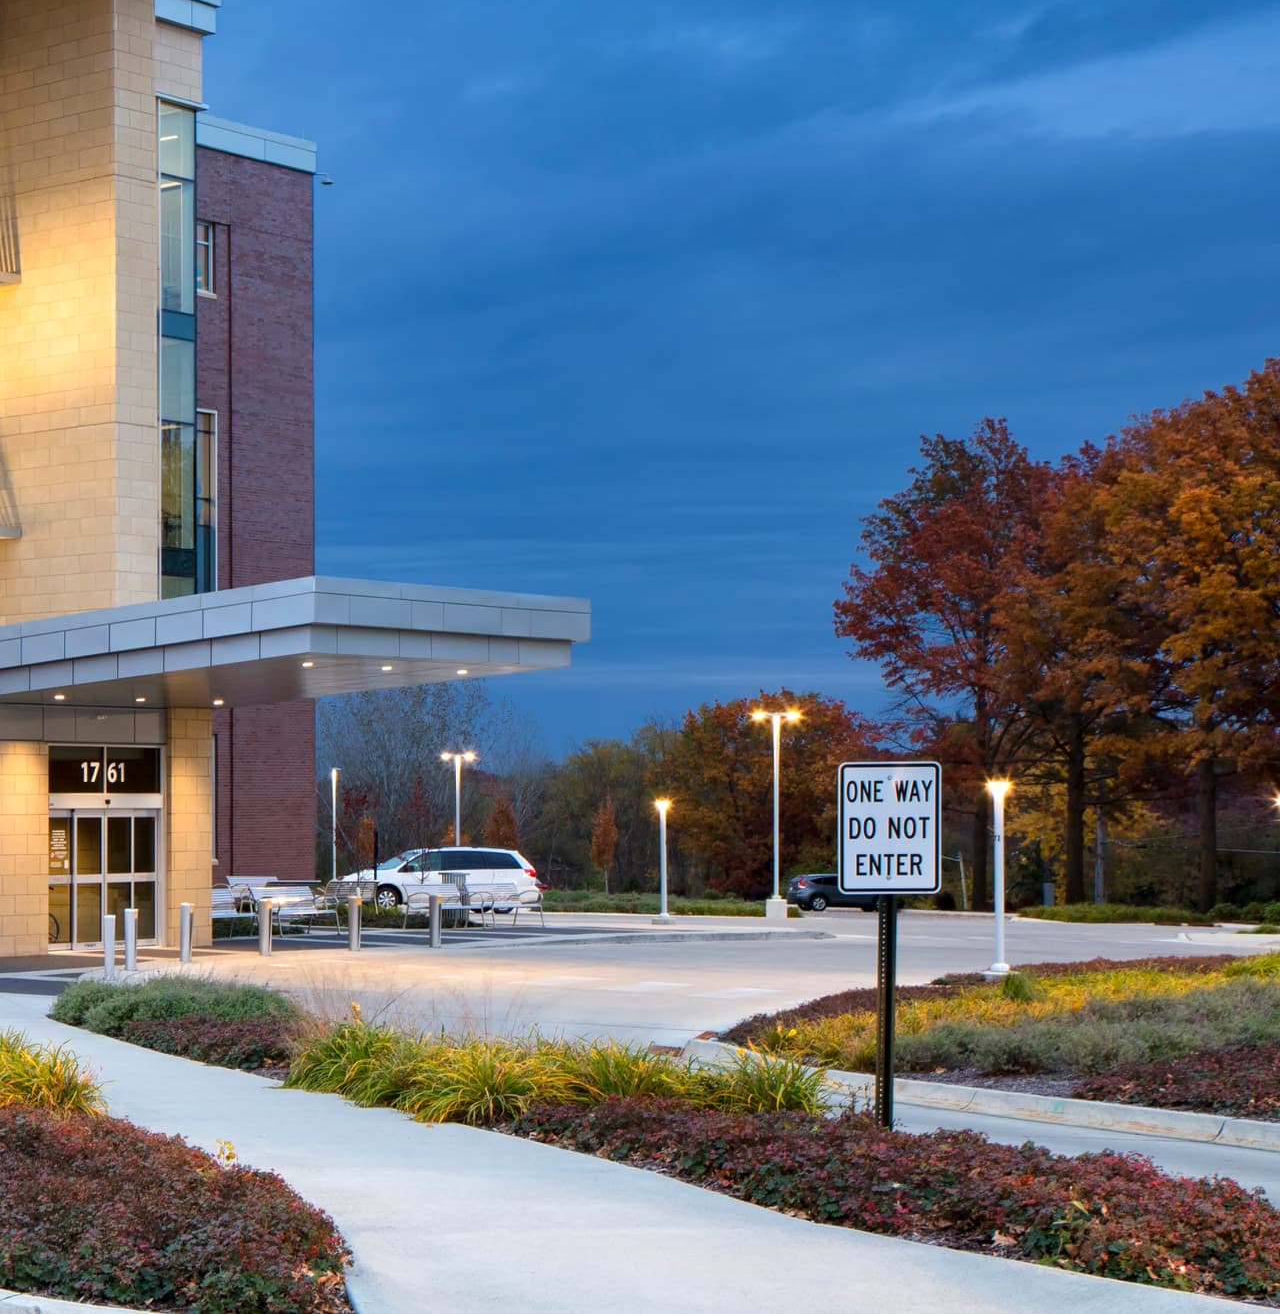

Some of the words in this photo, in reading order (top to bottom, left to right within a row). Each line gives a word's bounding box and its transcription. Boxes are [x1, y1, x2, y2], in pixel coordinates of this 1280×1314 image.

[80, 761, 126, 783] 1761
[846, 779, 884, 803] ONE
[894, 779, 933, 803] WAY
[848, 816, 876, 840] DO
[888, 816, 930, 840] NOT
[855, 853, 923, 876] ENTER
